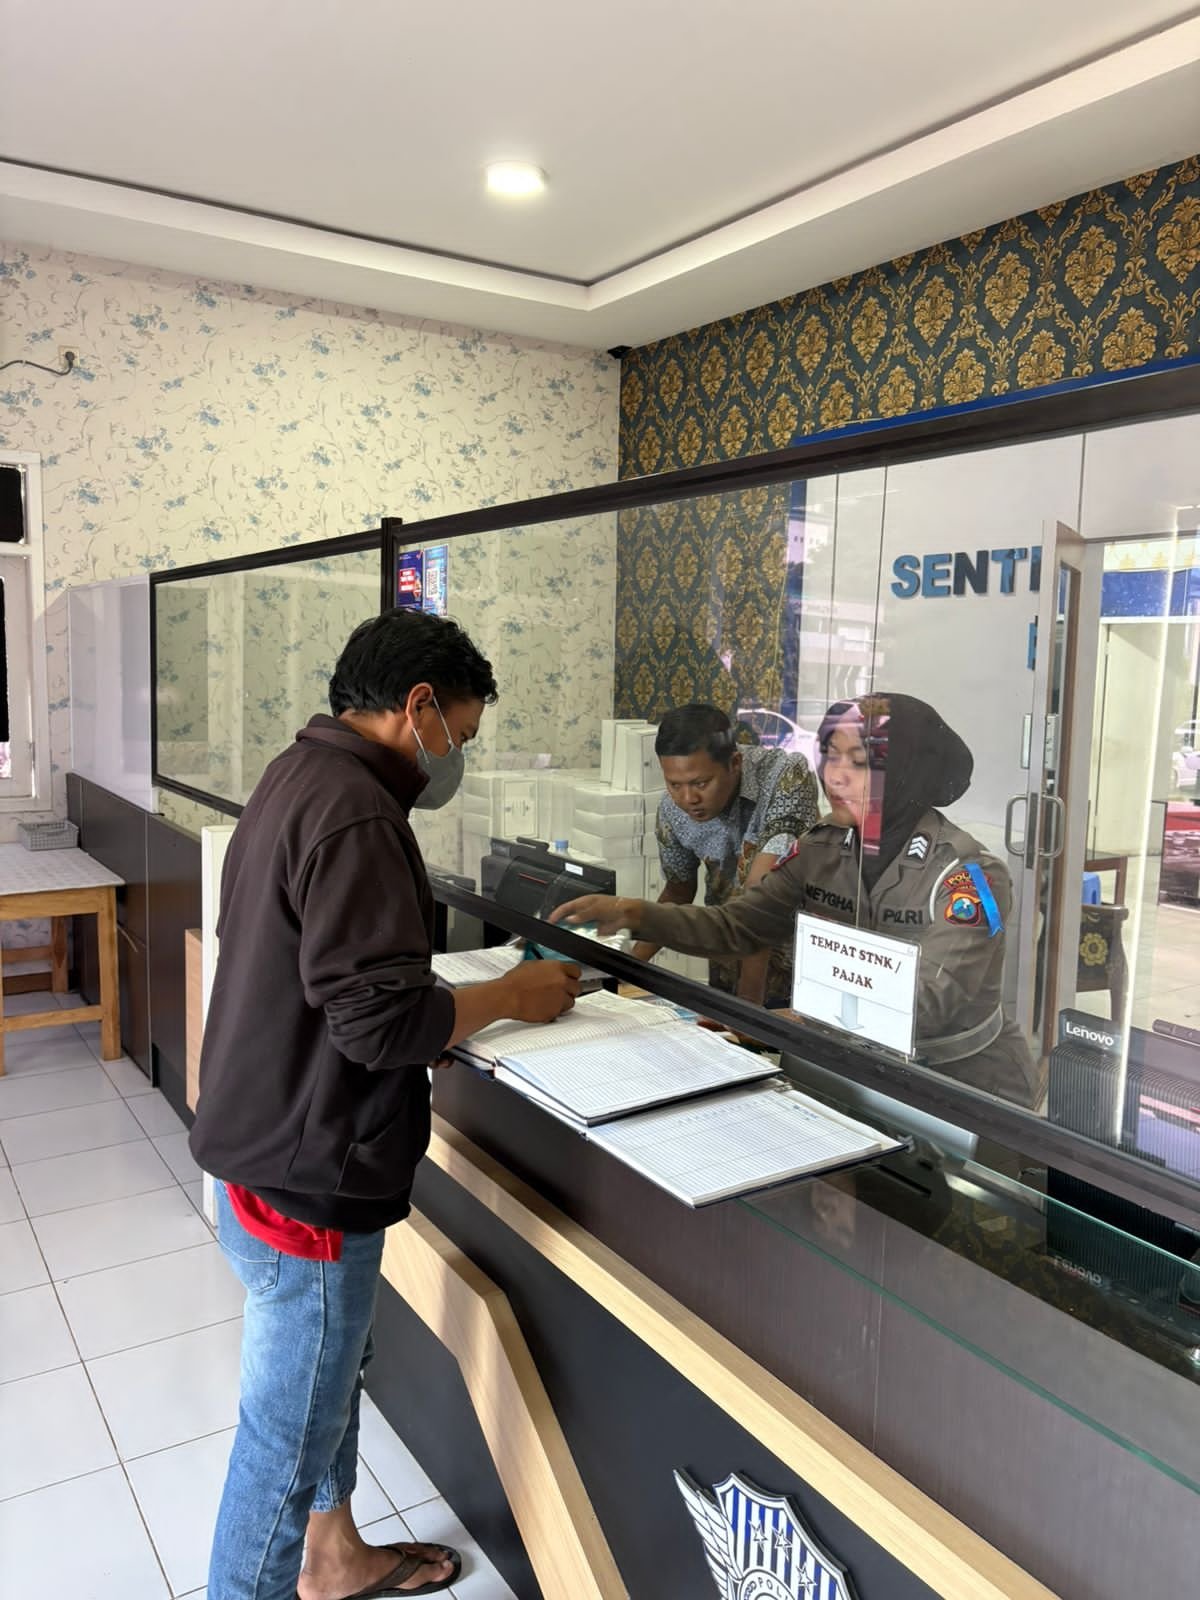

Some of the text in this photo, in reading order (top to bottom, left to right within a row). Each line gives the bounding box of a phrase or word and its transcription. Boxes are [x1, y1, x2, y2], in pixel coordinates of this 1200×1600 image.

[810, 934, 857, 959] TEMPAT
[859, 949, 893, 970] STNK
[832, 966, 873, 989] PAJAK
[1065, 1021, 1114, 1046] Lenovo
